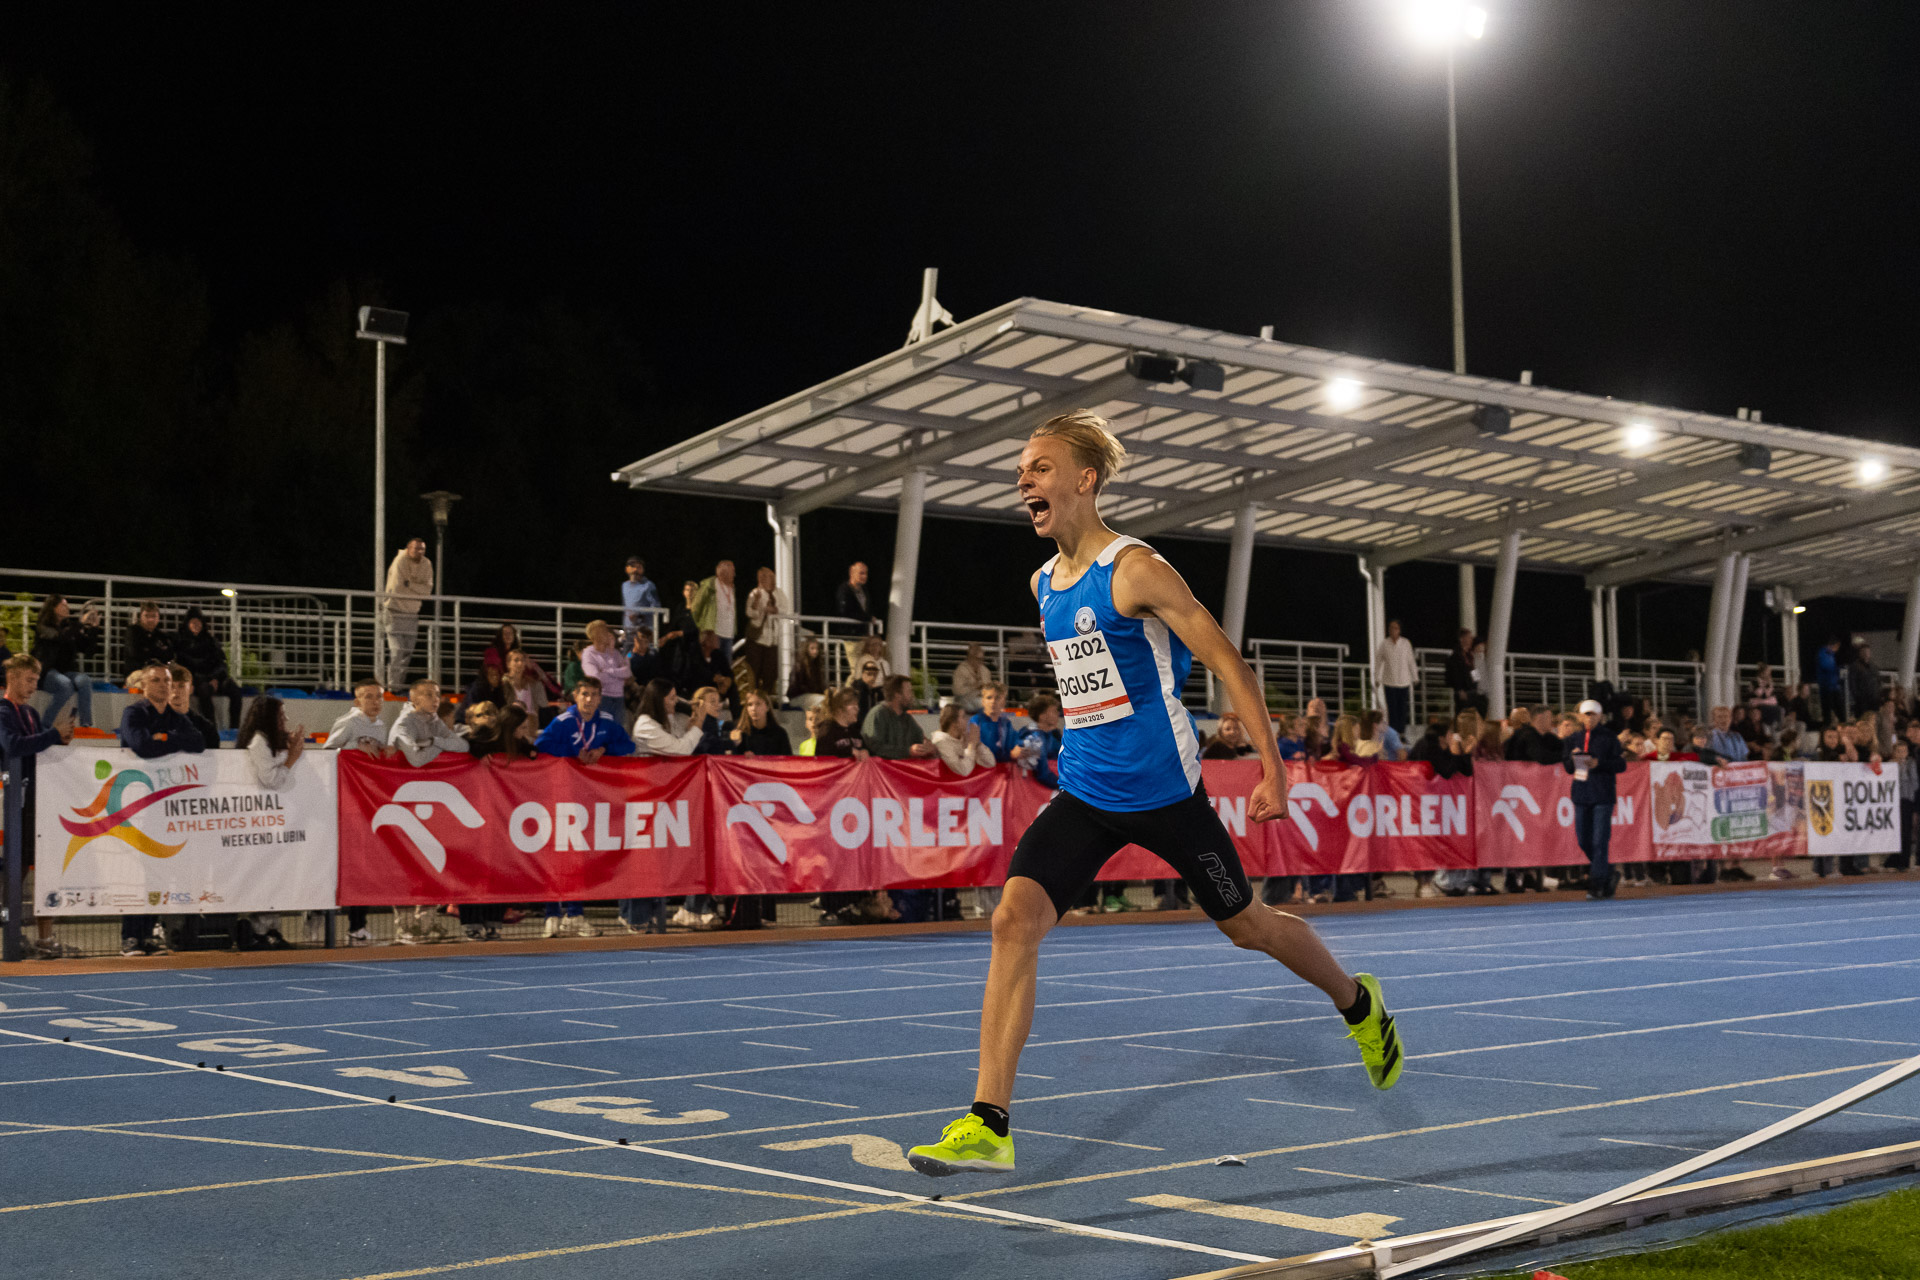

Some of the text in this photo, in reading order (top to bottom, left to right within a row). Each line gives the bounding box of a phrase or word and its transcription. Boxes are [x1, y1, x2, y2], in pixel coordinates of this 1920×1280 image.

[1065, 637, 1106, 661] 1202
[1058, 668, 1114, 697] OGUSZ
[1072, 713, 1105, 725] LUBIN 2026
[156, 763, 199, 787] RUN
[1843, 780, 1896, 804] DOLNY
[165, 794, 284, 817] INTERNATIONAL
[1347, 794, 1467, 838] ORLEN
[166, 814, 286, 833] ATHLETICS KIDS
[509, 799, 691, 854] ORLEN
[830, 797, 1004, 850] ORLEN
[221, 830, 306, 848] WEEKEND LUBIN
[176, 1037, 328, 1059] 5
[333, 1065, 473, 1088] 4
[530, 1095, 730, 1126] 3
[1127, 1193, 1404, 1239] 1
